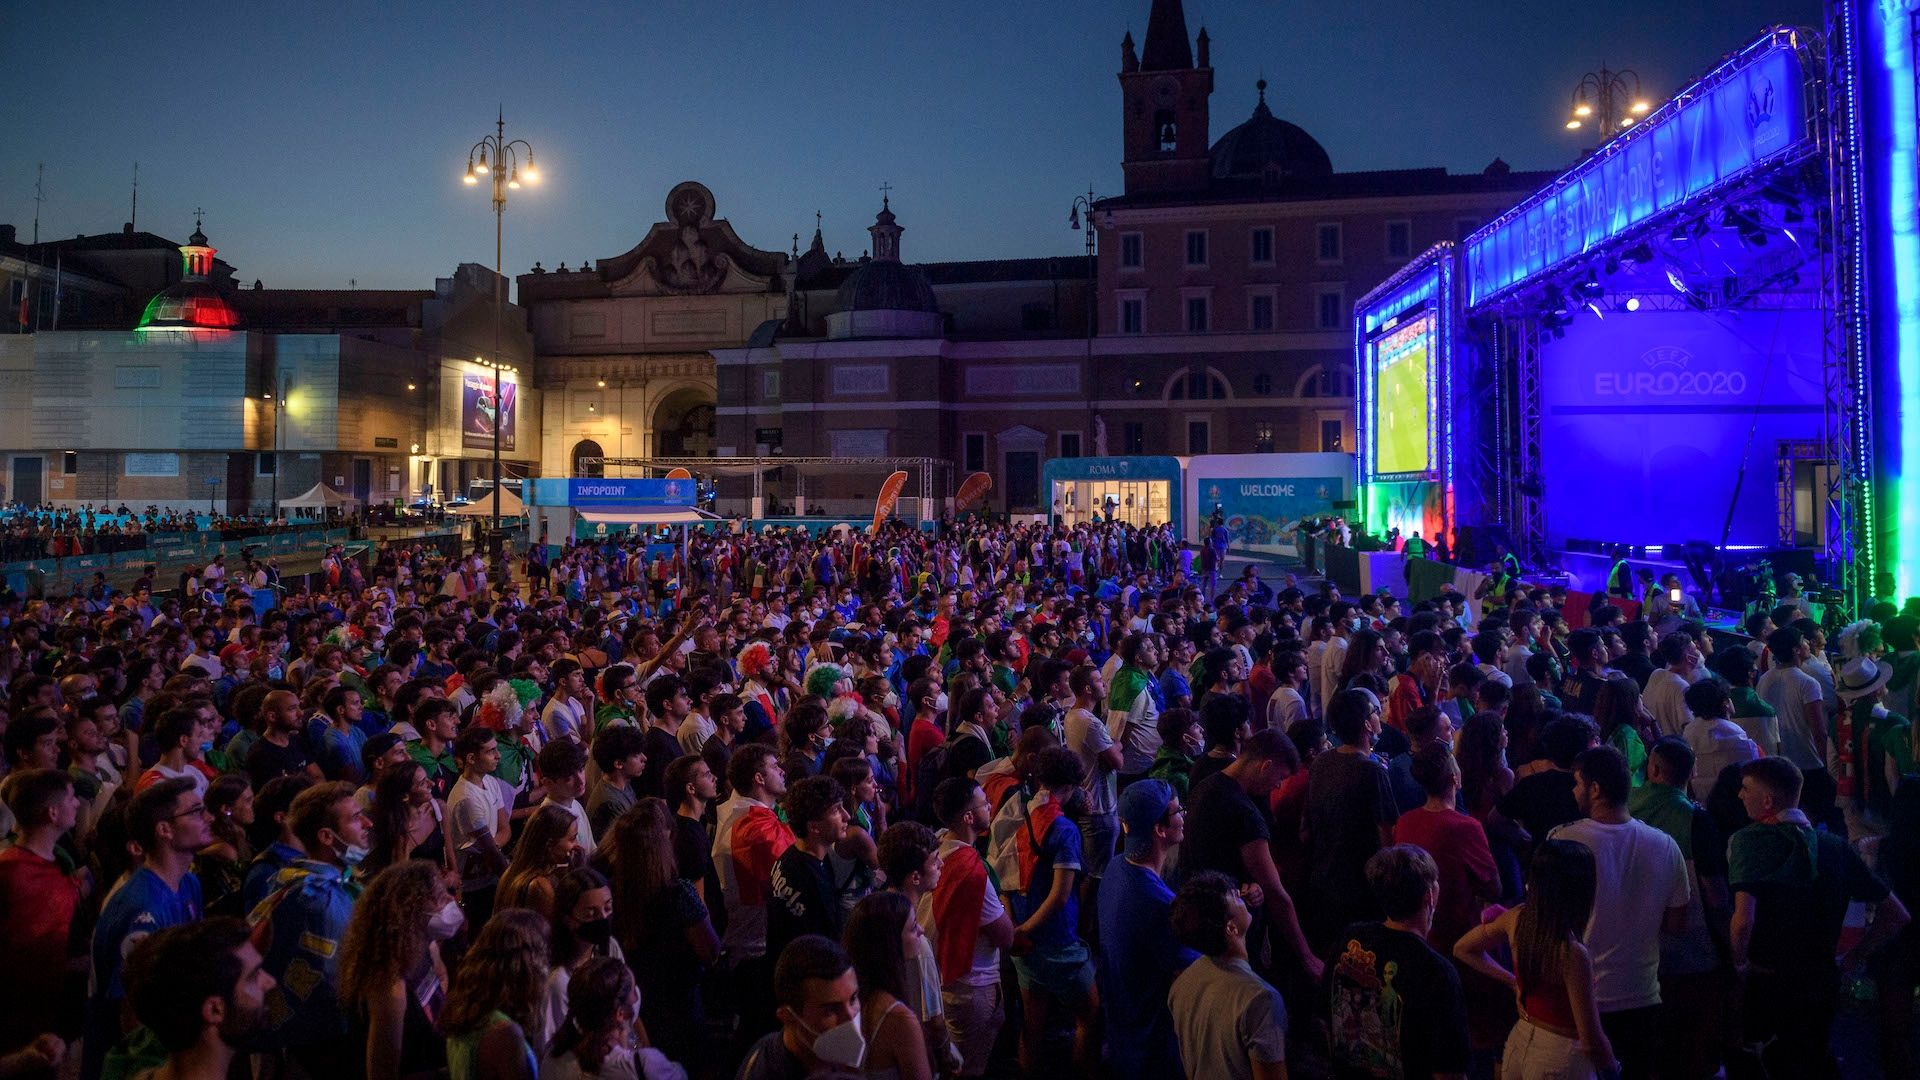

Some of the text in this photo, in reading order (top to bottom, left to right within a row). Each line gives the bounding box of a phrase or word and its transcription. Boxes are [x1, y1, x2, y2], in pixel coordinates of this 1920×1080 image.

[1520, 151, 1665, 261] UEFA FESTIVAL ROME
[1642, 350, 1690, 367] UEFA
[1595, 371, 1747, 395] EURO2020
[1089, 464, 1116, 475] ROMA
[577, 486, 627, 496] INFOPOINT
[1240, 484, 1296, 497] WELCOME
